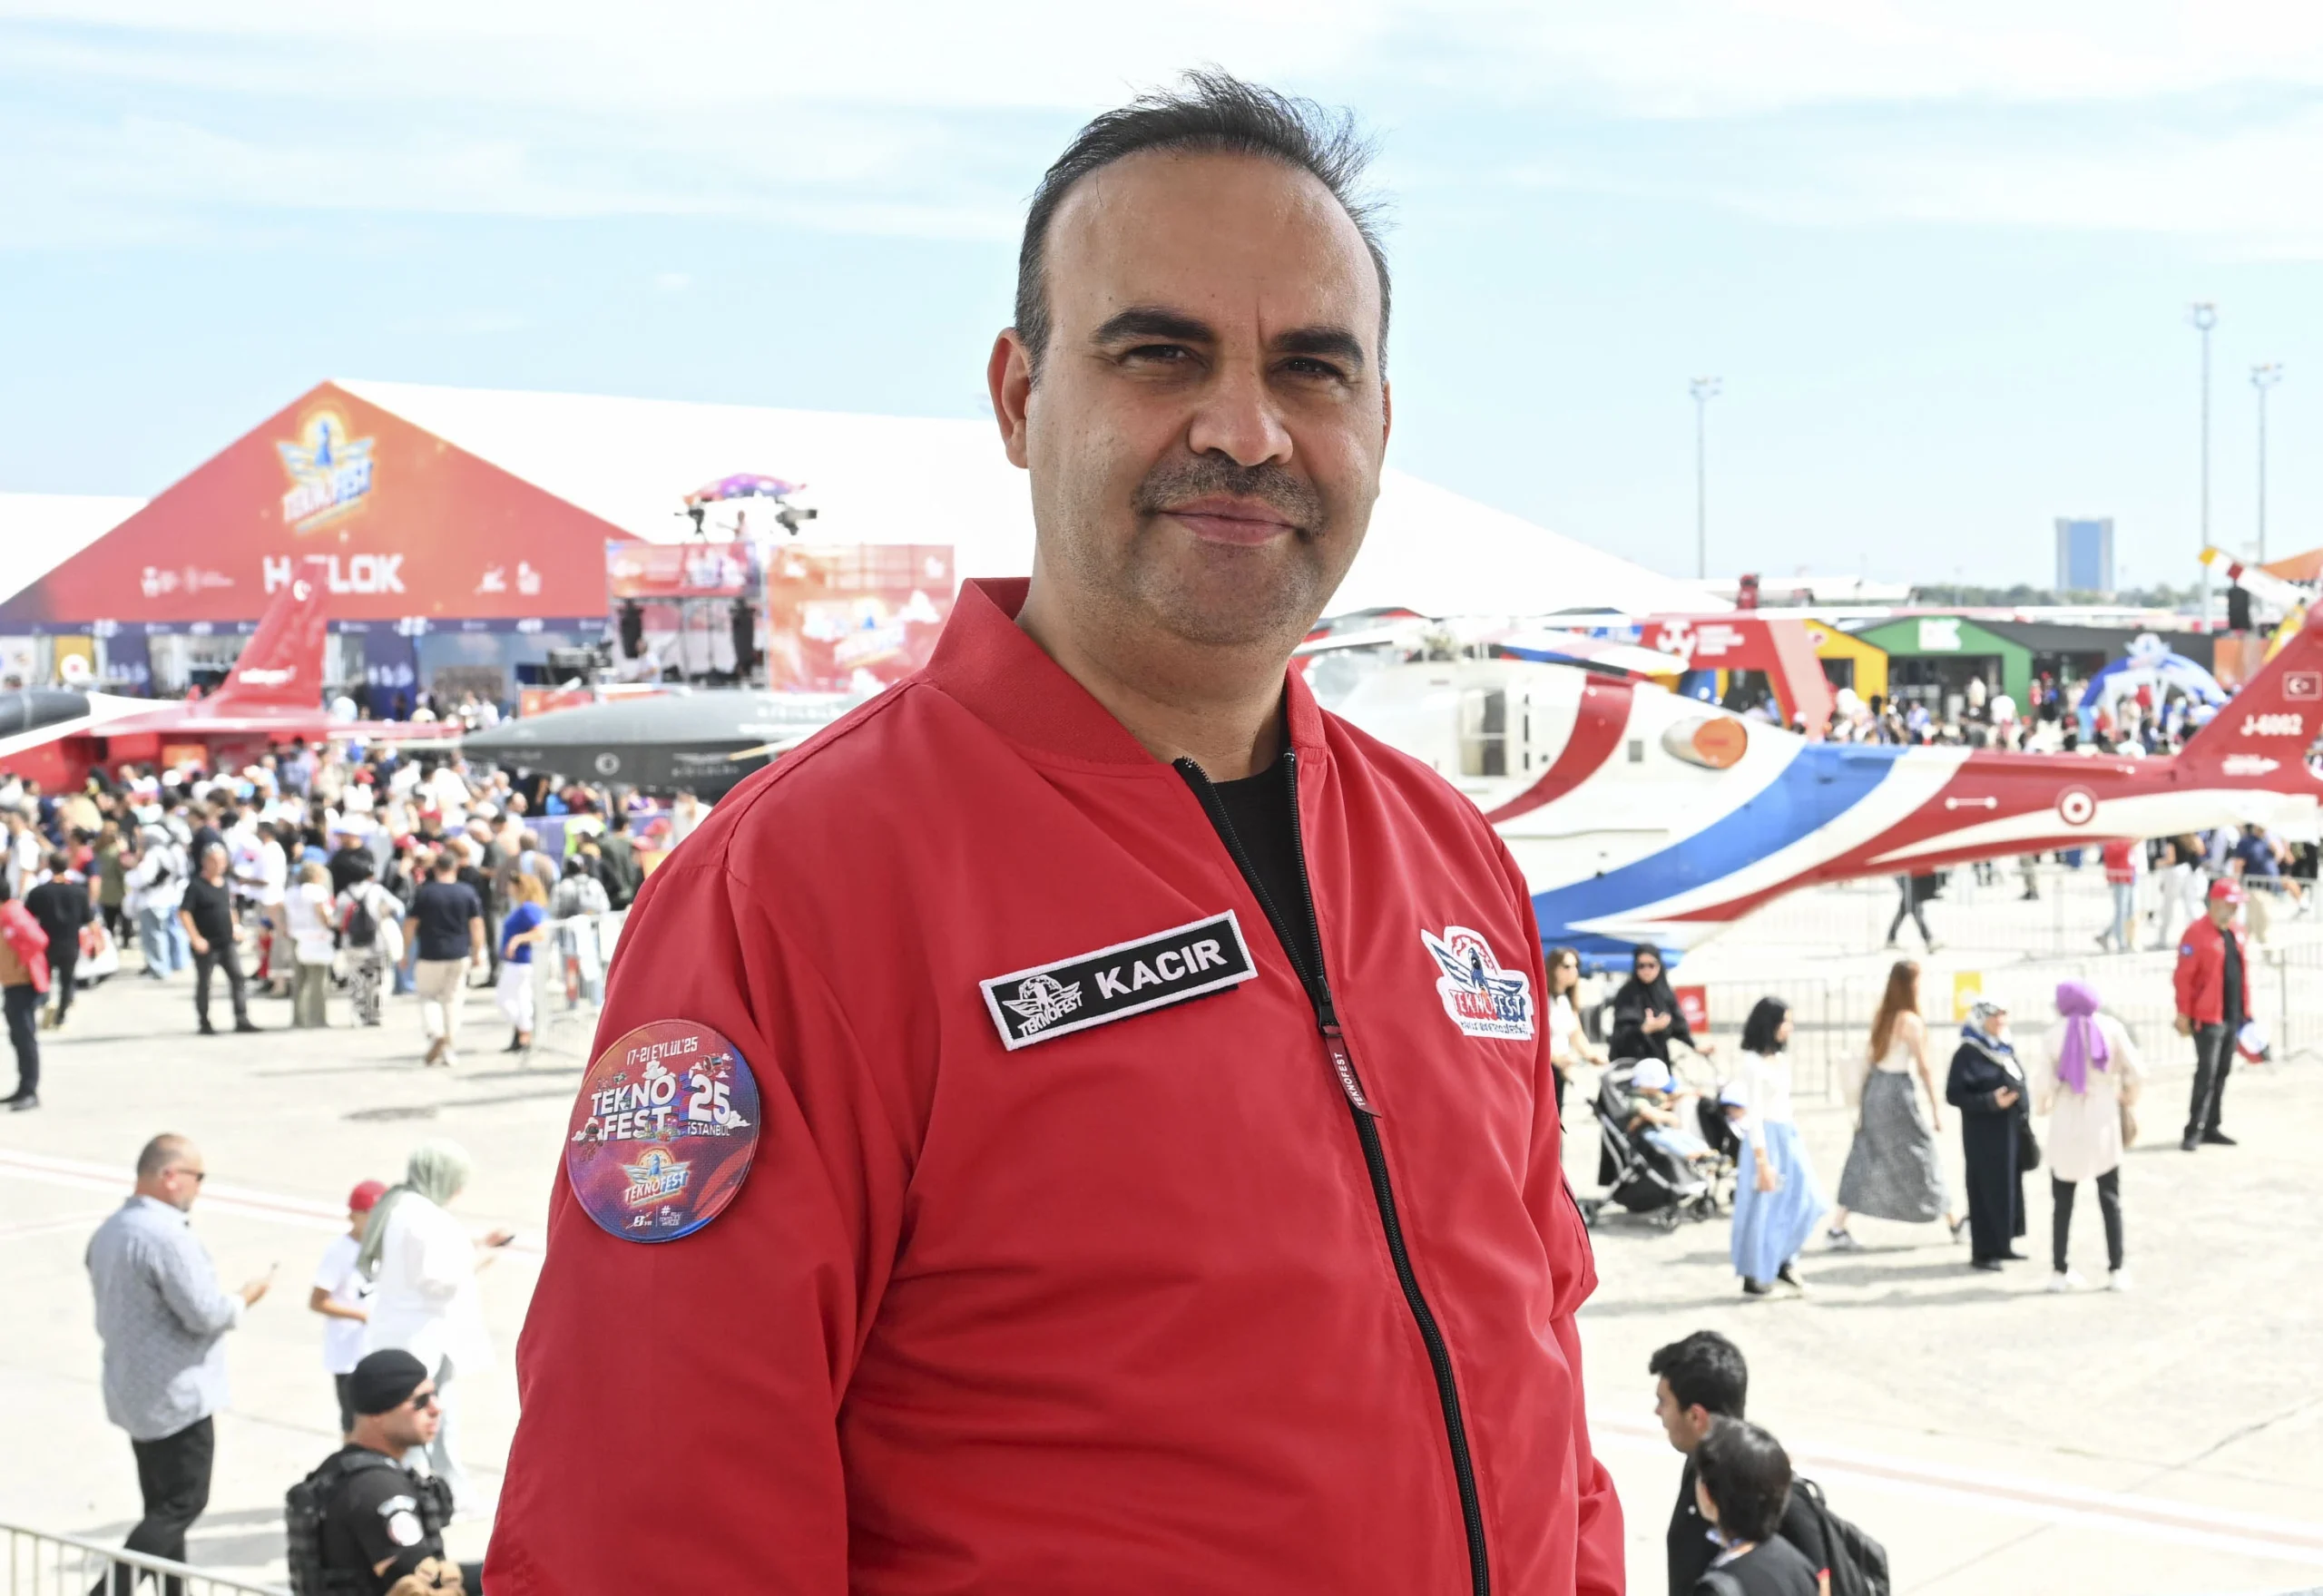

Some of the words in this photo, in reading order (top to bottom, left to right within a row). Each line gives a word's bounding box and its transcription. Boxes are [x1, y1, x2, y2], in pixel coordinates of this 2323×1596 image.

[304, 553, 406, 594] LOK
[1094, 938, 1229, 1000] KACIR
[1017, 991, 1083, 1037] TEKNOFEST
[1449, 989, 1526, 1023] TEKNOFEST
[591, 1075, 676, 1117] TEKNO
[689, 1073, 730, 1125] 25
[1334, 1053, 1366, 1106] TEKNOFEST
[603, 1106, 672, 1141] FEST
[624, 1170, 688, 1203] TEKNOFEST
